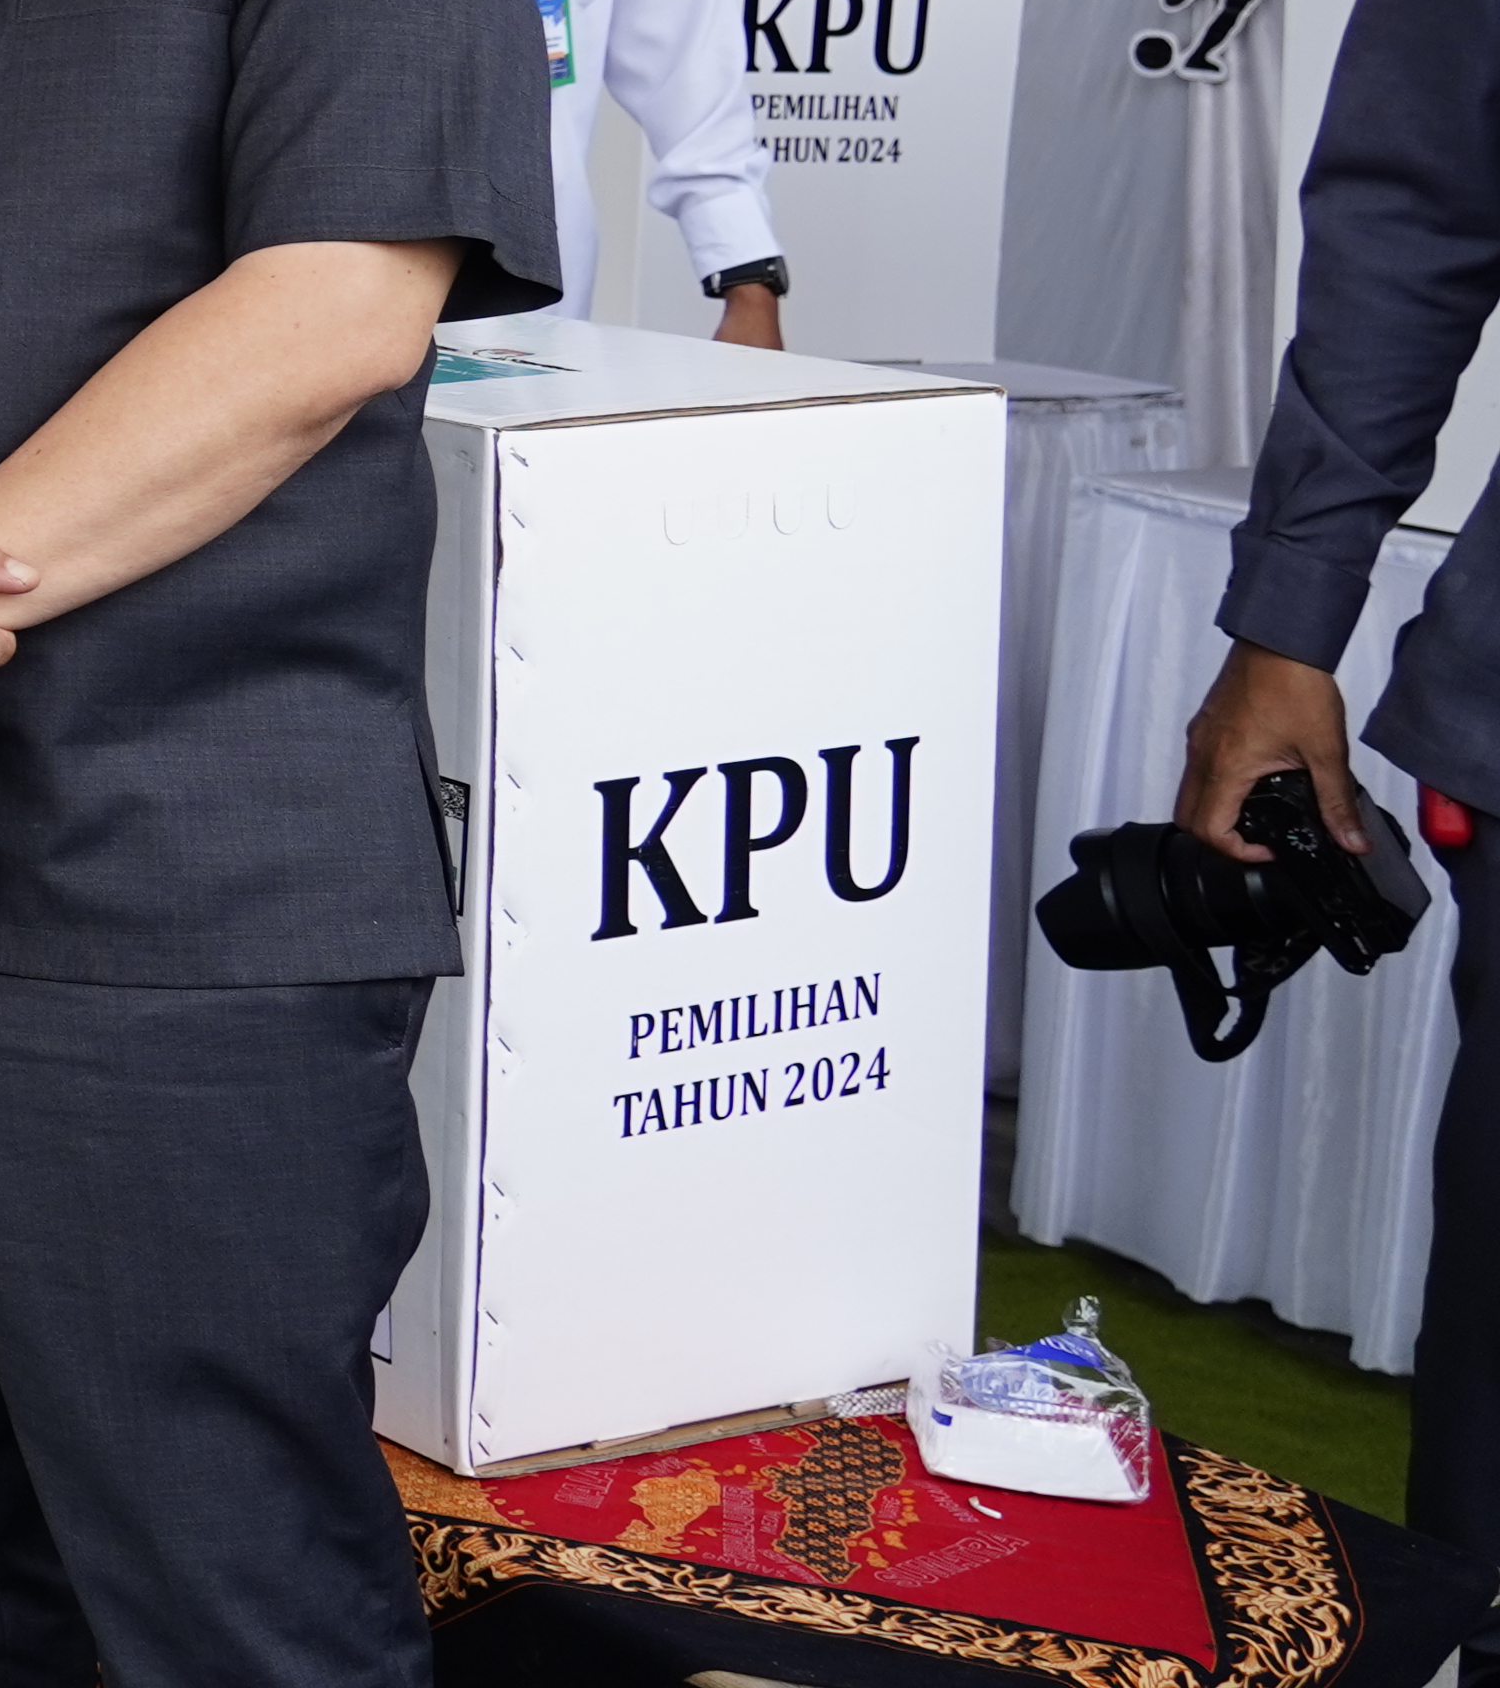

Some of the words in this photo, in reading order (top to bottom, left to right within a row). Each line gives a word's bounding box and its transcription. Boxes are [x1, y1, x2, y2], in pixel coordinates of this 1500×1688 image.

[751, 93, 899, 121] PEMILIHAN
[754, 136, 830, 163] HUN
[837, 137, 903, 163] 2024
[591, 735, 921, 943] KPU
[627, 973, 883, 1060] PEMILIHAN
[613, 1067, 770, 1140] TAHUN
[783, 1047, 892, 1110] 2024
